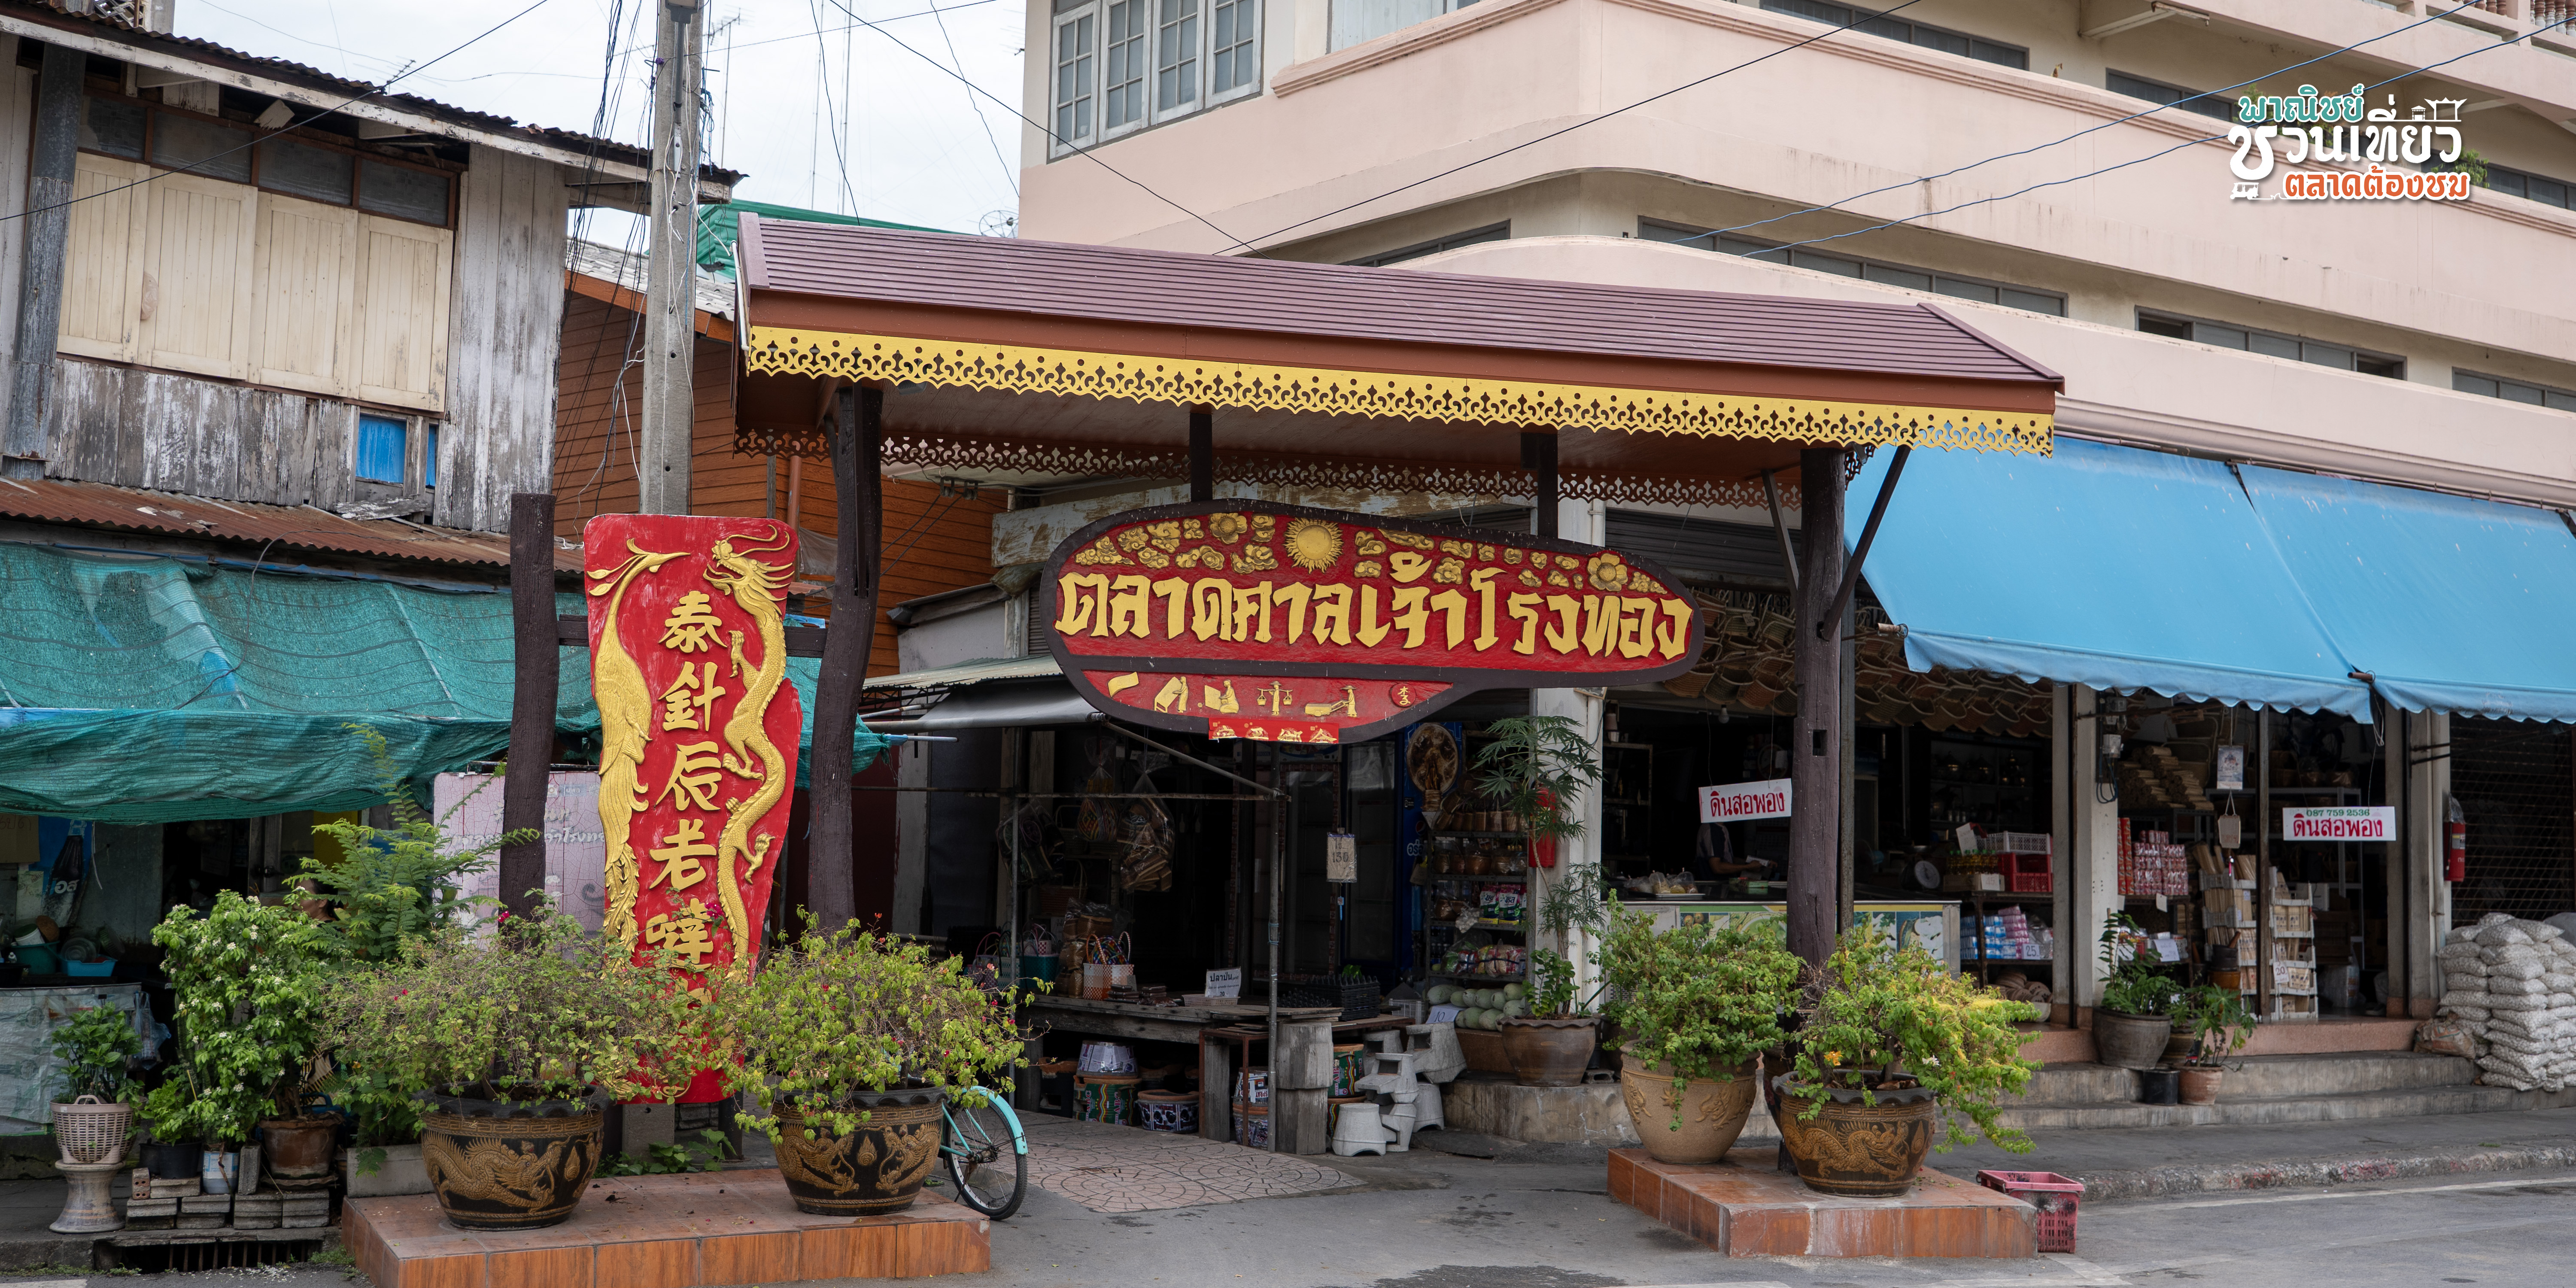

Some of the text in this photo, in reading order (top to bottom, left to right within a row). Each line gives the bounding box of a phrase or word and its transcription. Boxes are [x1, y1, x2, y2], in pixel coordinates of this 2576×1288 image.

[1054, 551, 1693, 660] ตลาดศาลเจ้าโรงทอง
[1709, 790, 1785, 817] ดินสอพอง
[2293, 813, 2383, 837] ดินสอพอง
